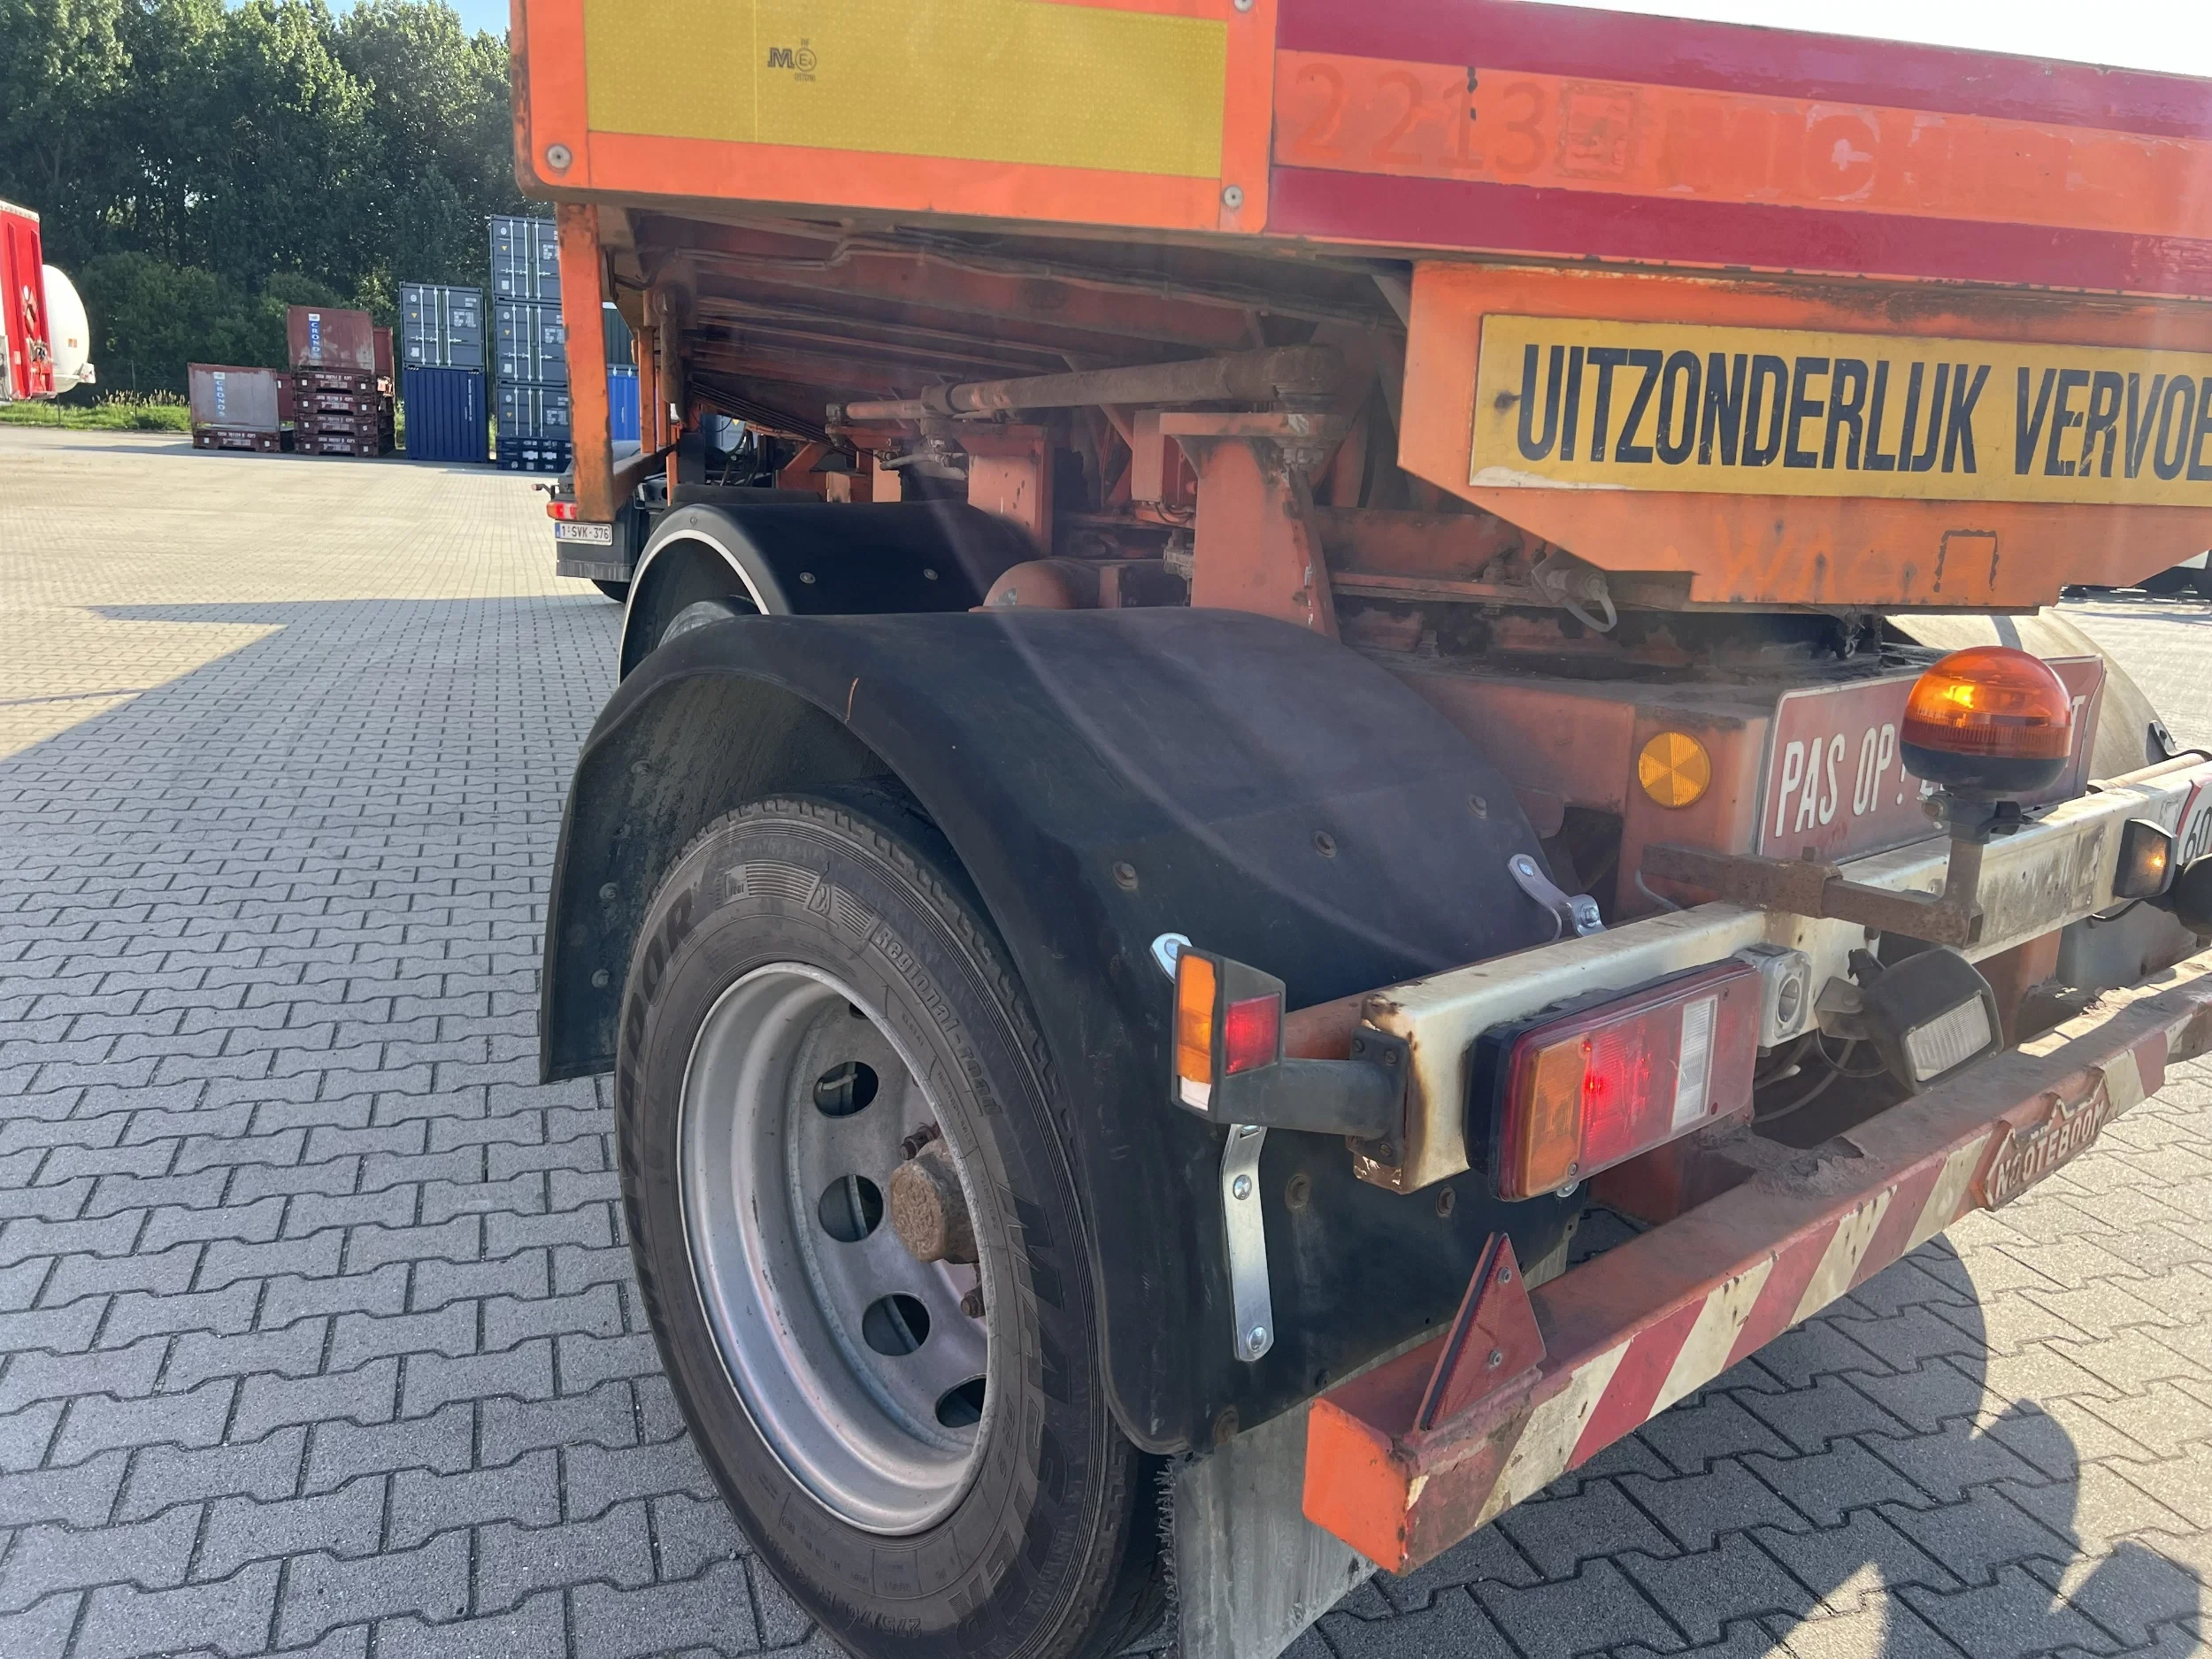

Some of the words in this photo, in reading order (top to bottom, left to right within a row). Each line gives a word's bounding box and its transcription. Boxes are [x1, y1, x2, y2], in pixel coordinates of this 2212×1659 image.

[1517, 343, 1991, 474] UITZONDERLIJK
[1775, 733, 1846, 838] PAS
[1995, 1100, 2104, 1199] NOOTEBOOM
[944, 1172, 1076, 1653] MASTER
